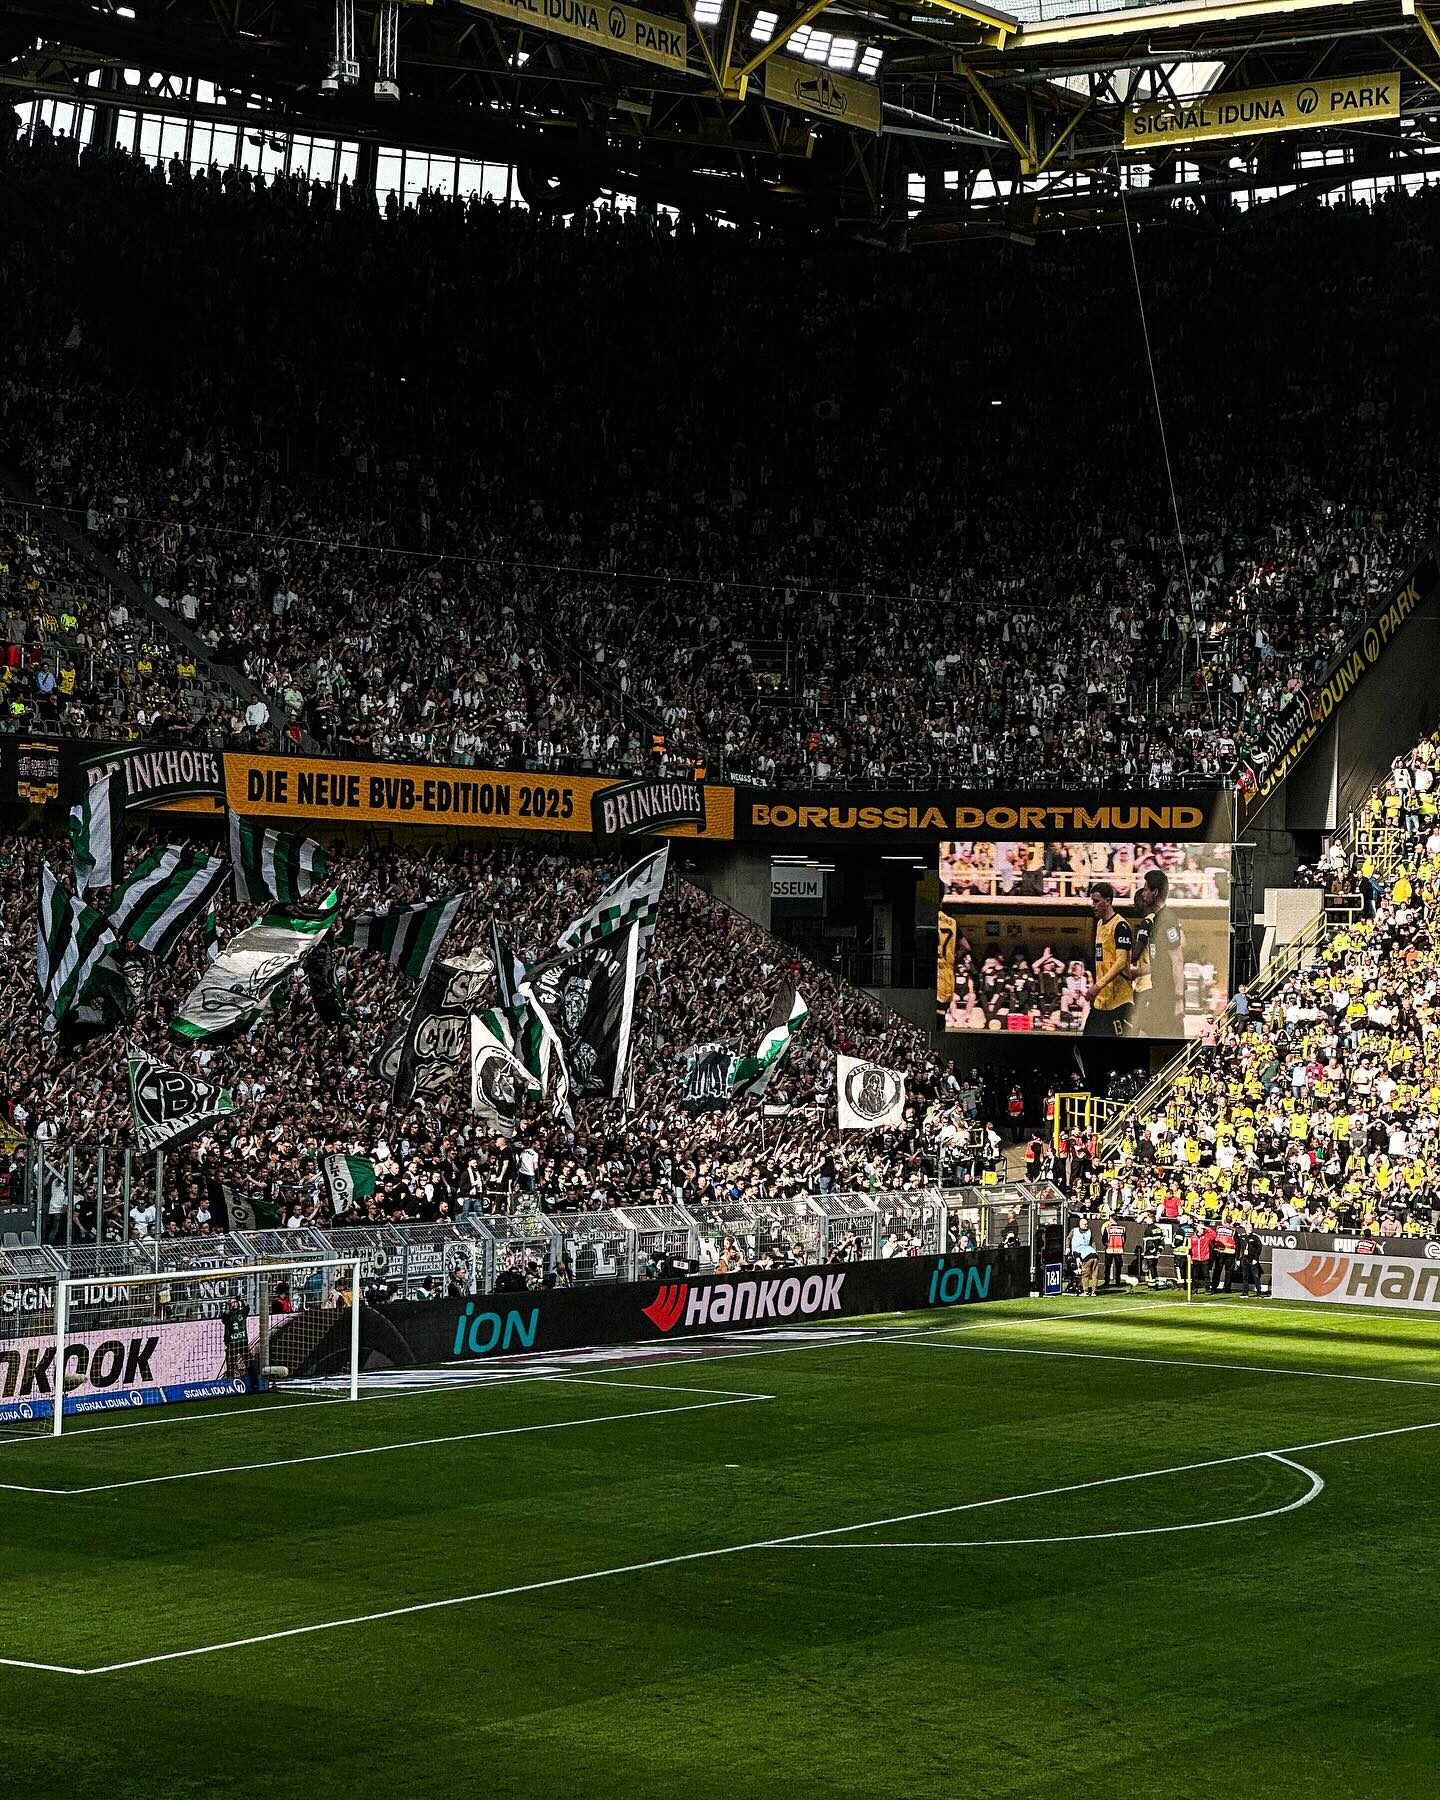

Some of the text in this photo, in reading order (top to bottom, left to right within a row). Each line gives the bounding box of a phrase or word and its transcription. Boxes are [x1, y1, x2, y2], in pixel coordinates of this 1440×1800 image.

[544, 0, 682, 57] IDUNA PARK
[1133, 86, 1391, 135] SIGNAL IDUNA PARK
[1320, 577, 1421, 719] DUNA PARK
[86, 751, 219, 795] INKHOFF's
[247, 768, 573, 819] DIE NEUE BVB-EDITION 2025
[752, 803, 1204, 829] BORUSSIA DORTMUND
[1334, 1237, 1360, 1253] PU
[1046, 1270, 1060, 1287] 1&1
[3, 1284, 130, 1313] SIGNL IDUN
[76, 1400, 131, 1412] SIGNAL IDUNA
